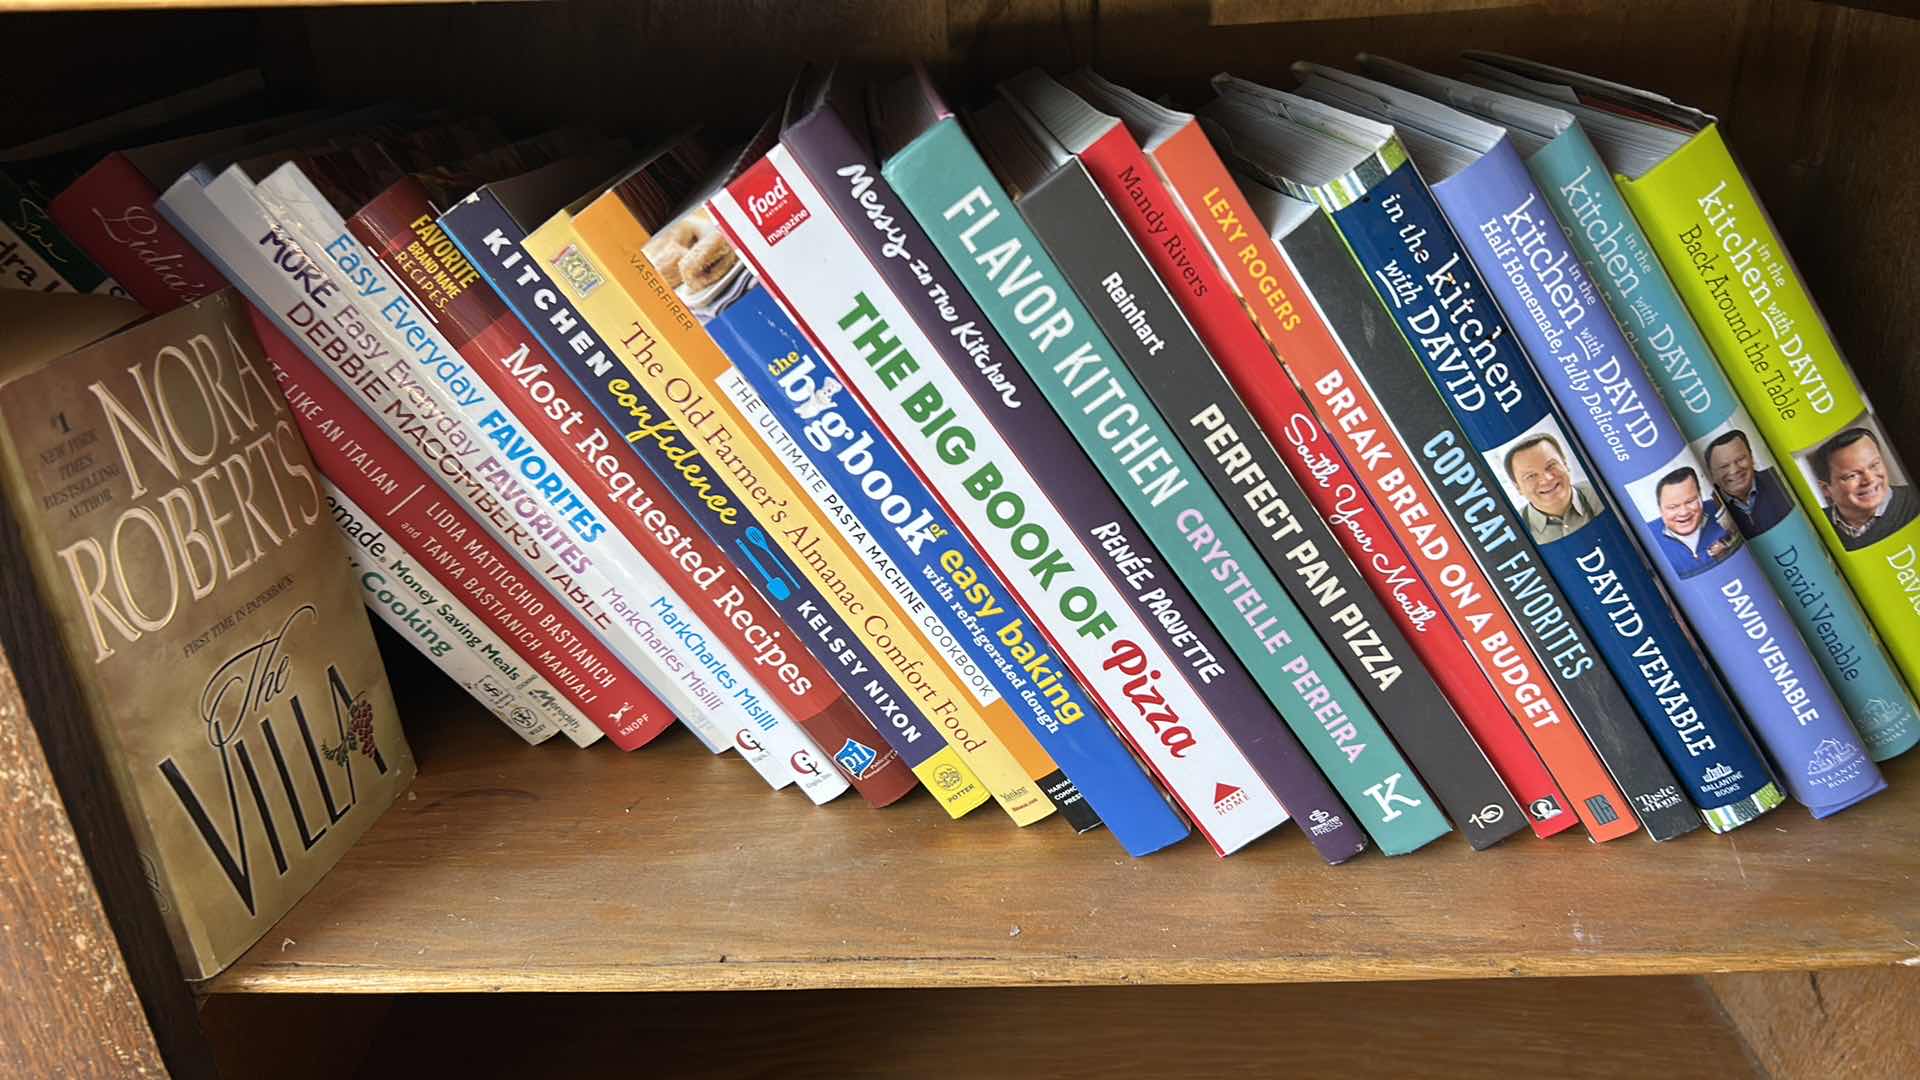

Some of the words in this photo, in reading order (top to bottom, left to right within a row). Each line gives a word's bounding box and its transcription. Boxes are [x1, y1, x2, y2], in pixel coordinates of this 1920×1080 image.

[410, 214, 482, 288] FAVORITE
[748, 176, 789, 226] food
[767, 209, 808, 244] magazine
[1117, 165, 1169, 234] Mandy
[1162, 232, 1209, 298] Rivers
[1202, 186, 1249, 244] LEXY
[1237, 242, 1303, 333] ROGERS
[1502, 192, 1588, 331] kitchen
[1560, 166, 1642, 299] kitchen
[1625, 233, 1637, 251] in
[1633, 247, 1652, 275] the
[1697, 179, 1774, 309] kitchen
[1758, 243, 1771, 262] in
[1767, 259, 1787, 288] the
[407, 241, 442, 276] BRAND
[434, 269, 462, 300] NAME
[630, 253, 695, 332] VASERFIRER
[836, 163, 911, 260] Messy
[909, 259, 934, 286] In
[927, 283, 959, 323] The
[950, 321, 1022, 409] Kitchen
[1101, 271, 1166, 356] Reinhart
[1380, 192, 1405, 224] in
[1399, 223, 1431, 265] the
[1425, 252, 1524, 414] kitchen
[1384, 259, 1424, 306] with
[1407, 304, 1486, 413] DAVID
[1568, 264, 1581, 281] in
[1577, 279, 1597, 305] the
[1678, 222, 1715, 277] Back
[1704, 272, 1761, 346] Around
[1744, 341, 1770, 374] the
[1762, 368, 1797, 421] Table
[1767, 300, 1792, 336] with
[259, 230, 341, 308] MORE
[333, 304, 389, 361] Easy
[384, 358, 482, 459] Everyday
[474, 455, 594, 576] FAVORITES
[324, 233, 388, 298] Easy
[380, 296, 485, 409] Everyday
[477, 409, 608, 544] FAVORITES
[482, 227, 615, 377] KITCHEN
[607, 378, 737, 526] confidence
[768, 350, 800, 377] the
[1479, 216, 1514, 260] Half
[1502, 257, 1563, 355] Homemade,
[1558, 352, 1591, 393] Fully
[1582, 392, 1630, 464] Delicious
[1580, 327, 1603, 358] with
[1593, 355, 1659, 450] DAVID
[1634, 294, 1660, 328] with
[1648, 323, 1713, 415] DAVID
[1779, 334, 1836, 415] DAVID
[88, 322, 284, 500] NORA
[284, 384, 323, 421] LIKE
[317, 419, 345, 443] AN
[340, 440, 398, 496] ITALIAN
[286, 301, 391, 402] DEBBIE
[384, 400, 542, 560] MACOMBER'S
[544, 564, 613, 631] TABLE
[943, 185, 1076, 353] FLAVOR
[1053, 341, 1190, 508] KITCHEN
[1176, 507, 1292, 656] CRYSTELLE
[1281, 655, 1368, 763] PEREIRA
[57, 420, 320, 662] ROBERTS
[501, 343, 584, 435] Most
[576, 429, 725, 591] Requested
[713, 584, 814, 698] Recipes
[620, 321, 666, 378] The
[664, 377, 716, 430] Old
[703, 424, 789, 525] Farmer's
[784, 523, 866, 615] Almanac
[864, 614, 938, 703] Comfort
[933, 697, 988, 753] Food
[729, 377, 761, 414] THE
[759, 413, 826, 494] ULTIMATE
[823, 493, 869, 545] PASTA
[866, 545, 926, 613] MACHINE
[923, 615, 995, 697] COOKBOOK
[836, 430, 937, 556] book
[837, 290, 921, 391] THE
[900, 380, 976, 466] BIG
[961, 460, 1076, 591] BOOK
[1058, 585, 1118, 640] OF
[1102, 638, 1197, 760] Pizza
[929, 522, 950, 540] of
[1189, 403, 1304, 542] PERFECT
[1285, 539, 1347, 608] PAN
[1329, 602, 1404, 692] PIZZA
[1284, 412, 1341, 489] South
[1328, 482, 1374, 553] Your
[1371, 552, 1438, 633] Mouth
[1313, 368, 1394, 473] BREAK
[1376, 466, 1450, 561] BREAD
[1439, 563, 1483, 609] ON
[1464, 612, 1495, 634] A
[1480, 630, 1561, 729] BUDGET
[1422, 429, 1518, 553] COPYCAT
[1496, 550, 1595, 681] FAVORITES
[184, 632, 210, 658] FIRST
[210, 616, 234, 638] TIME
[246, 574, 295, 614] PAPERBACK
[361, 570, 453, 659] Cooking
[389, 559, 438, 606] Money
[436, 603, 483, 650] Saving
[481, 643, 520, 682] Meals
[400, 521, 420, 540] and
[421, 538, 462, 581] TANYA
[463, 577, 540, 651] BASTIANICH
[538, 649, 598, 705] MANUALI
[426, 502, 469, 544] LIDIA
[464, 538, 544, 617] MATTICCHIO
[539, 612, 617, 689] BASTIANICH
[601, 586, 685, 673] MarkCharles
[680, 669, 725, 712] Misilli
[650, 596, 738, 690] MarkCharles
[733, 686, 780, 733] Misilli
[921, 564, 955, 605] with
[951, 600, 1026, 690] refrigerated
[1020, 680, 1060, 736] dough
[940, 549, 1004, 618] easy
[996, 618, 1085, 726] baking
[1090, 520, 1154, 591] RENÉE
[1138, 586, 1226, 685] PAQUETTE
[1575, 546, 1645, 638] DAVID
[1631, 635, 1717, 758] VENABLE
[1720, 578, 1769, 641] DAVID
[1757, 634, 1820, 727] VENABLE
[1774, 544, 1824, 610] David
[1811, 600, 1862, 682] Venable
[201, 605, 317, 747] The
[619, 713, 650, 737] KNOPF
[796, 599, 868, 678] KELSEY
[863, 679, 923, 744] NIXON
[158, 665, 388, 916] VILLA
[948, 783, 975, 803] POTTER
[1635, 784, 1676, 807] Taste
[1700, 770, 1745, 793] BALLANTINE
[1714, 784, 1742, 799] BOOKS
[1808, 754, 1866, 787] BALLANTINE
